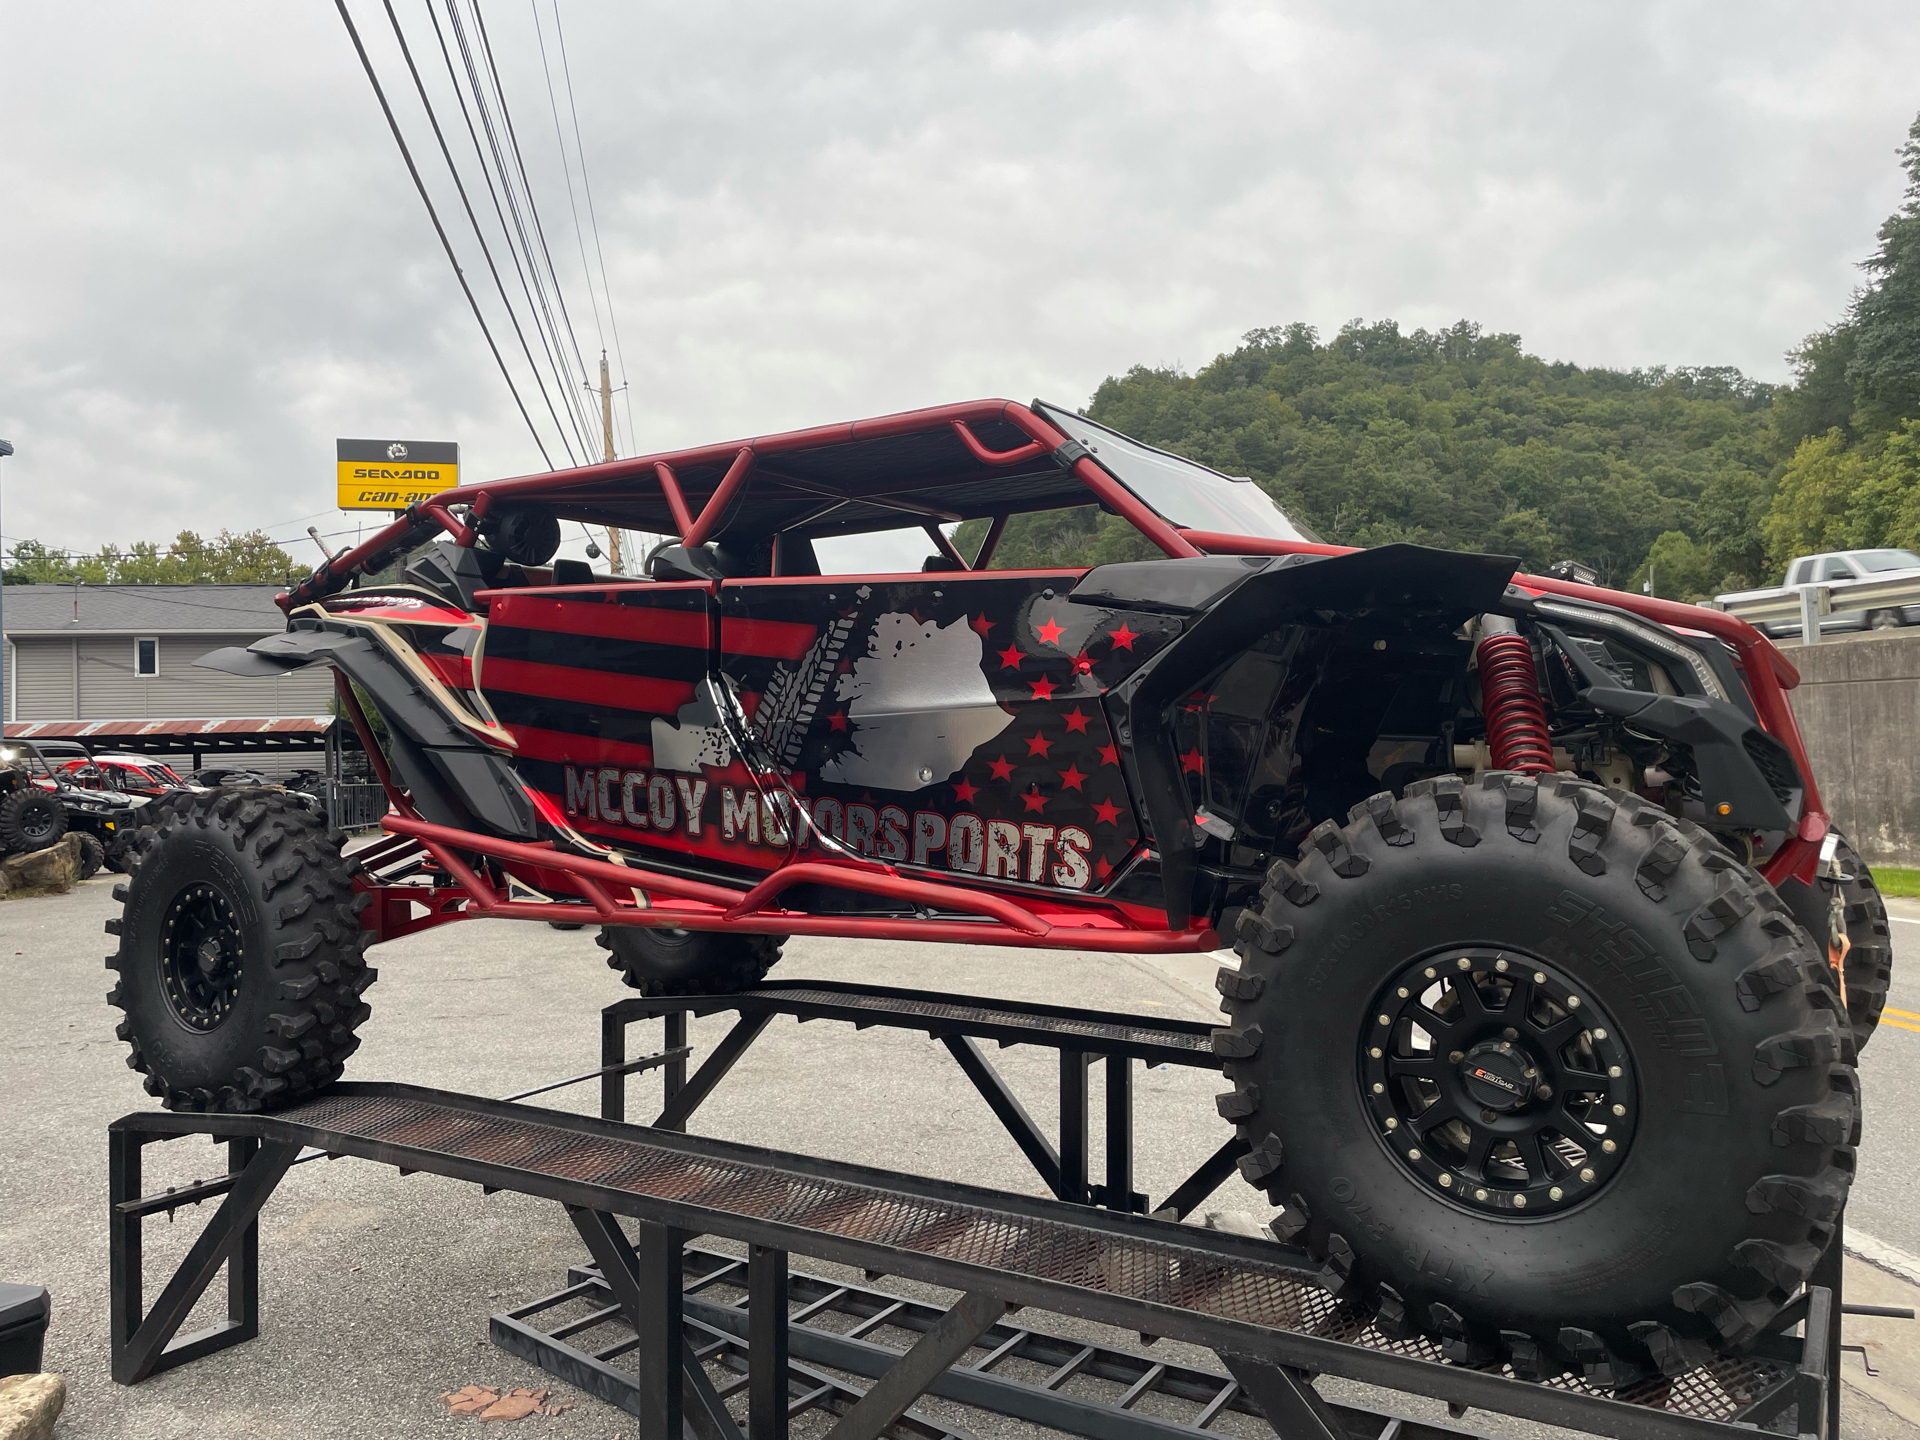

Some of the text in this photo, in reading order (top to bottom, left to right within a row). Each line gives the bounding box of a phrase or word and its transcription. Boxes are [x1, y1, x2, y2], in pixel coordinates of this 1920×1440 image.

[564, 765, 1093, 890] MCCOY MOTORSPORTS
[1545, 889, 1720, 1057] SYSTEM
